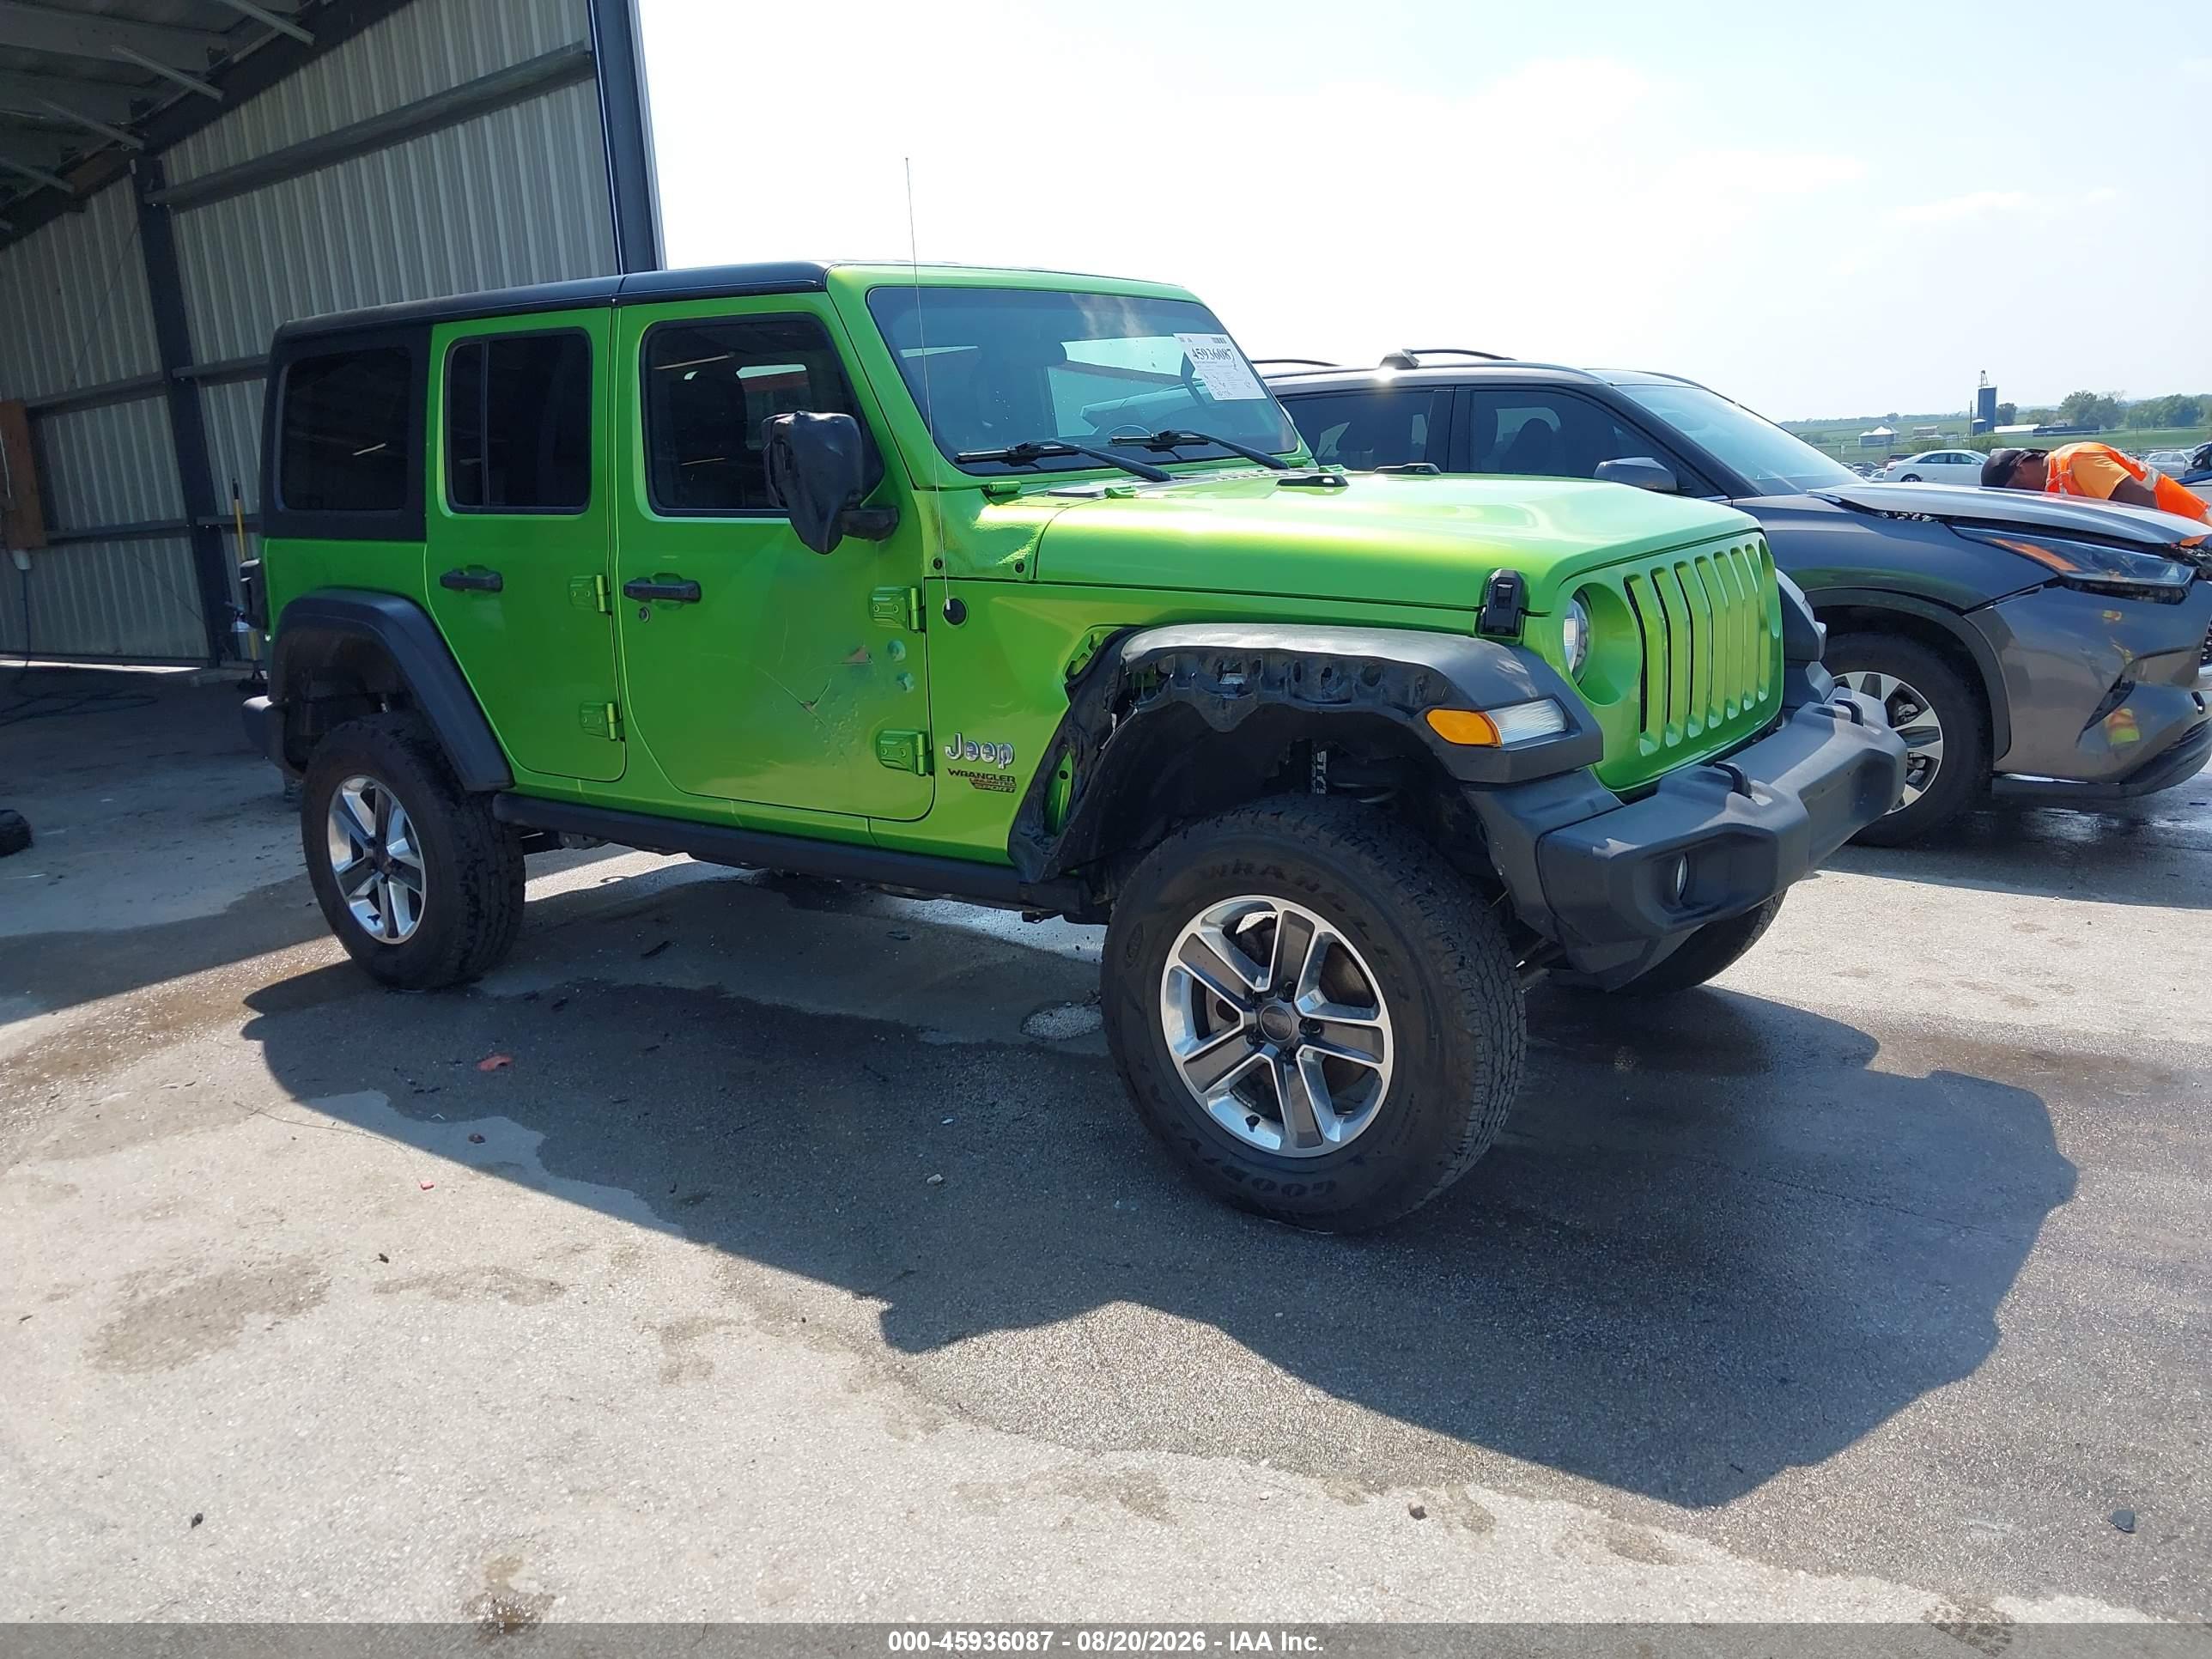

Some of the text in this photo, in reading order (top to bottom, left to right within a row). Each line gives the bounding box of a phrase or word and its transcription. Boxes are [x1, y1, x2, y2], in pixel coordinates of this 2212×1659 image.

[1192, 347, 1236, 362] 45936087
[945, 732, 1015, 769] Jeep
[948, 768, 1016, 782] WRANGLER
[975, 783, 1016, 793] SPORT
